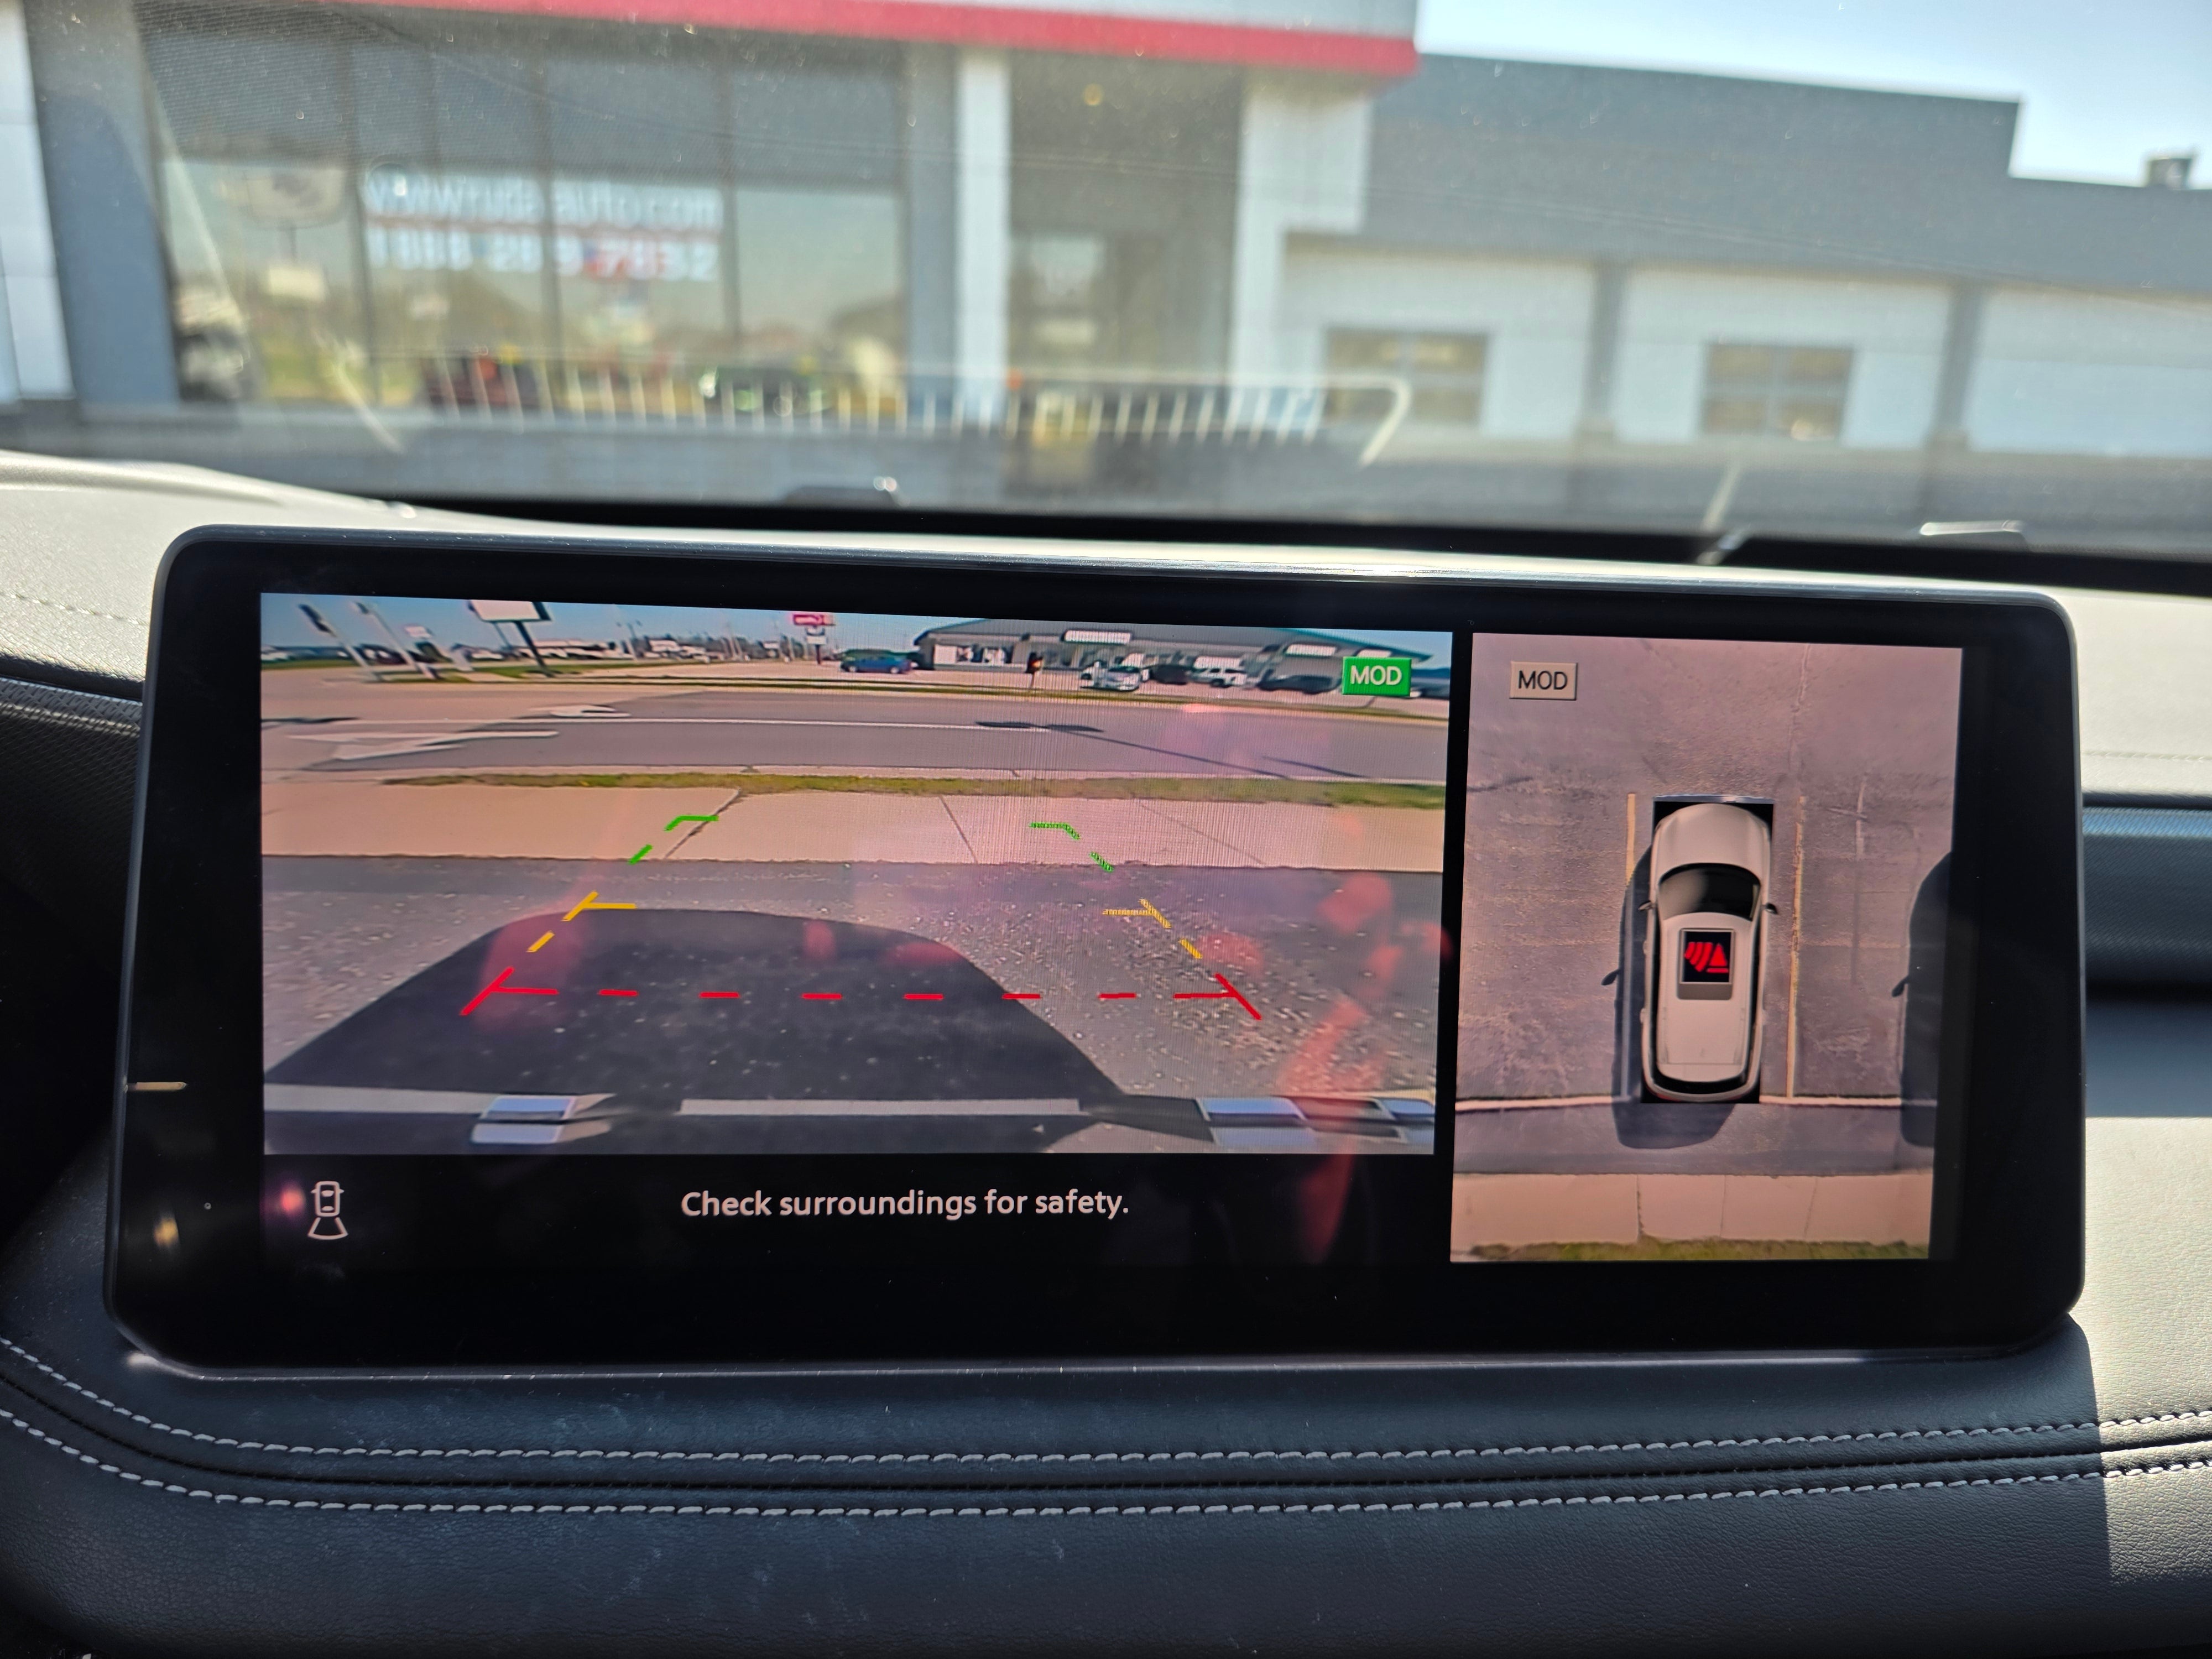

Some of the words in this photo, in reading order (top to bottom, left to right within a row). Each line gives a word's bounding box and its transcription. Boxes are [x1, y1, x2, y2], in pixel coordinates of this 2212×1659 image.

[1350, 665, 1402, 685] MOD
[1517, 670, 1569, 690] MOD
[681, 1190, 772, 1216] Check
[779, 1188, 977, 1220] surroundings
[984, 1188, 1028, 1214] for
[1035, 1188, 1129, 1219] safety.
